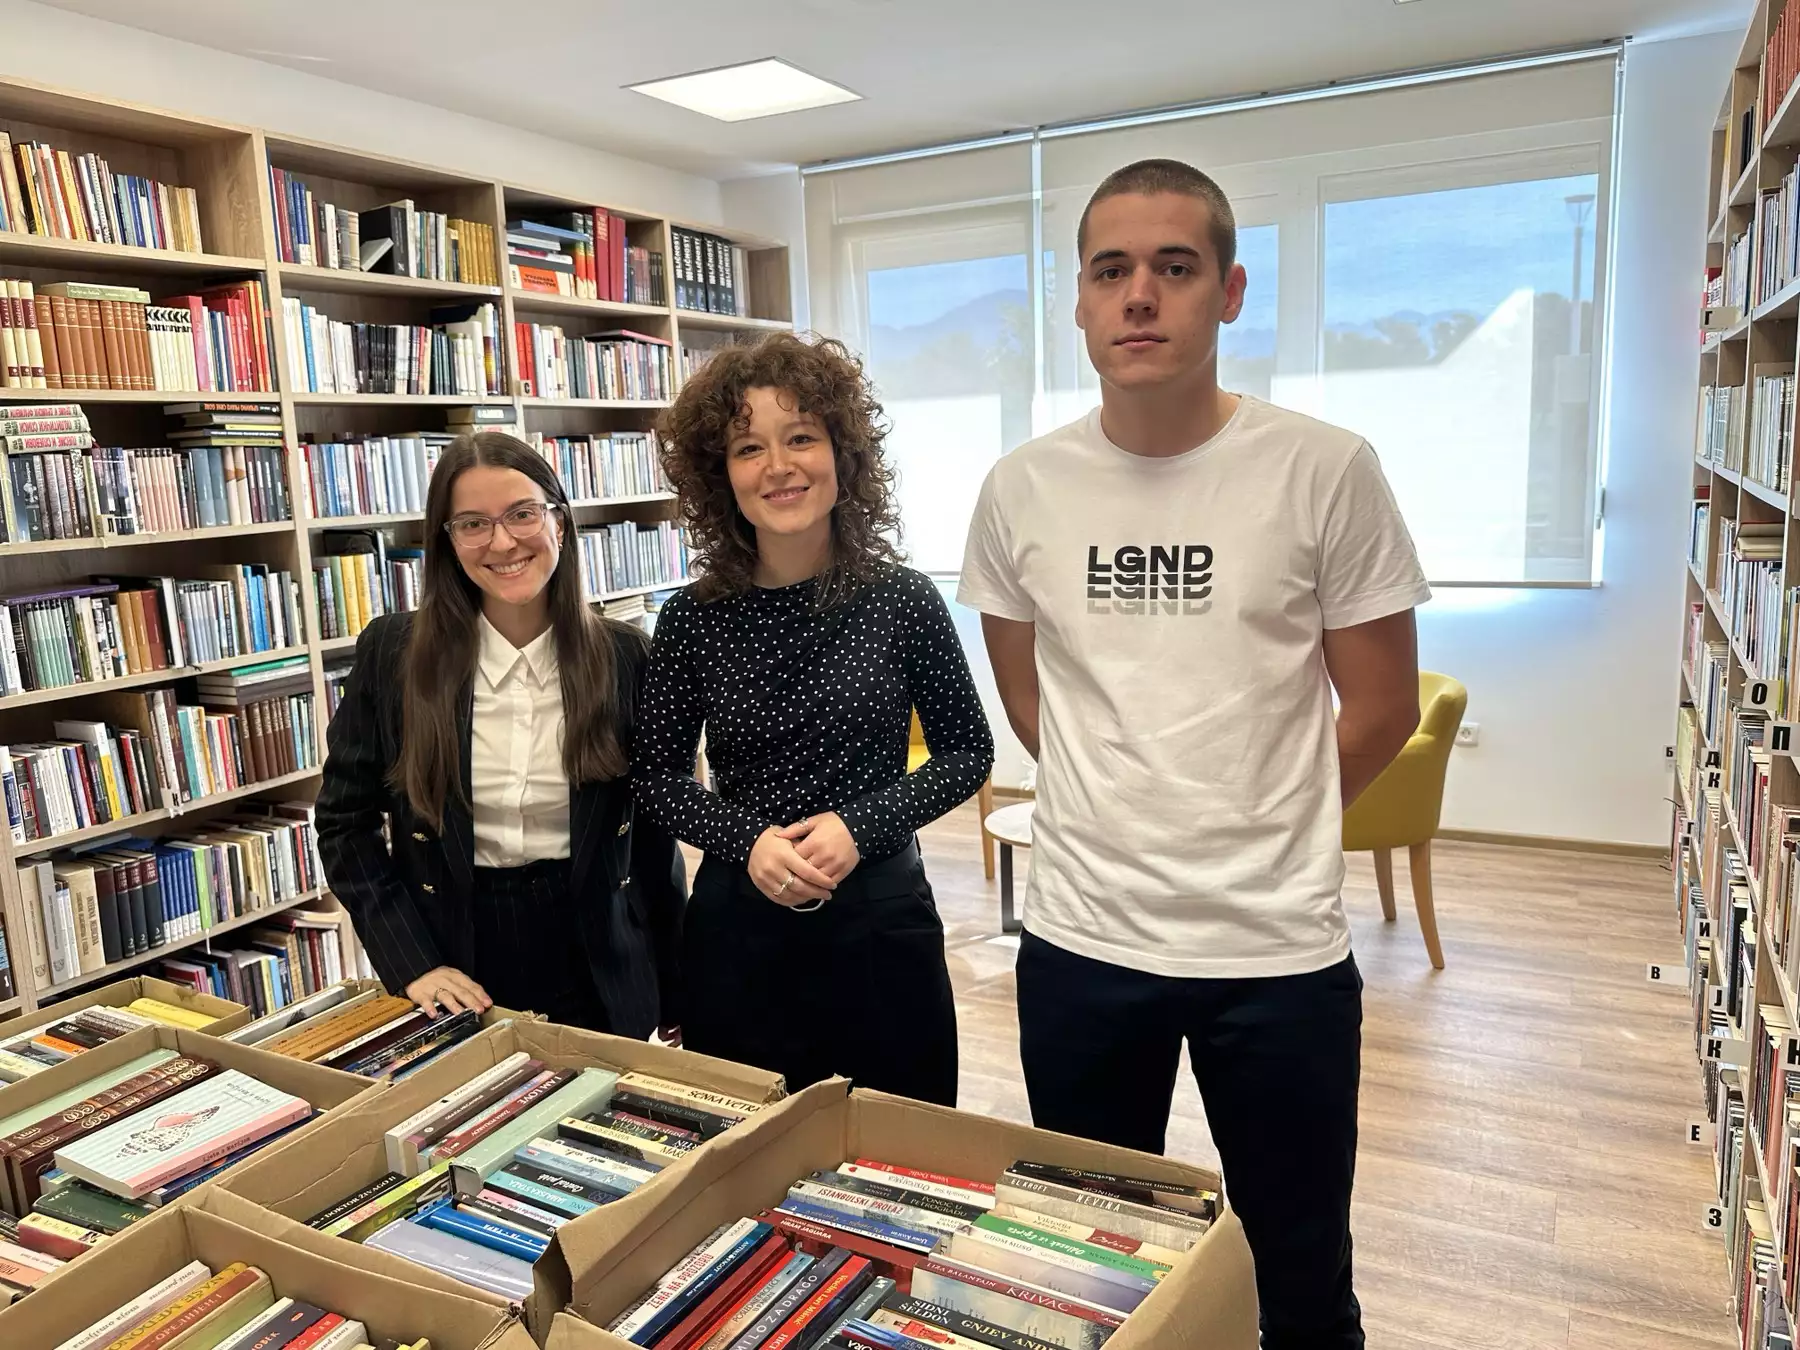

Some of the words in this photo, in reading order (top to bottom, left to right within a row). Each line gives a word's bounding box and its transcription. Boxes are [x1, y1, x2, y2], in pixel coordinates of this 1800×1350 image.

[1088, 545, 1213, 572] LGND
[1751, 683, 1768, 704] О
[1772, 726, 1790, 750] П
[1705, 751, 1720, 768] Д
[1708, 772, 1721, 788] К
[1700, 922, 1710, 936] И
[538, 1080, 554, 1092] AM
[517, 1088, 540, 1106] LOVE
[1022, 1181, 1048, 1192] KROFT
[324, 1197, 360, 1218] DOKTOR
[358, 1180, 390, 1200] ŽIVAGO
[818, 1188, 868, 1206] ISTANBULSKI
[871, 1200, 904, 1214] PROLAZ
[910, 1198, 968, 1216] PETROGRADU
[1076, 1194, 1121, 1212] NEVINA
[780, 1220, 801, 1230] HRAM
[800, 1226, 832, 1239] JAGUARA
[1007, 1226, 1036, 1242] Egipta
[1050, 1240, 1084, 1256] Odlazak
[179, 1269, 196, 1282] toni
[667, 1280, 683, 1292] NA
[678, 1252, 714, 1282] PROZORU
[926, 1262, 946, 1273] LIZA
[946, 1266, 996, 1287] BALANTAJN
[766, 1306, 786, 1324] ZA
[784, 1274, 818, 1310] DRAGO
[912, 1299, 950, 1316] SIDNI
[1007, 1286, 1072, 1312] KRIVAC
[118, 1305, 140, 1322] moja
[898, 1302, 950, 1325] ŠELDON
[73, 1320, 115, 1348] omiljena
[961, 1319, 1012, 1340] GNJEV
